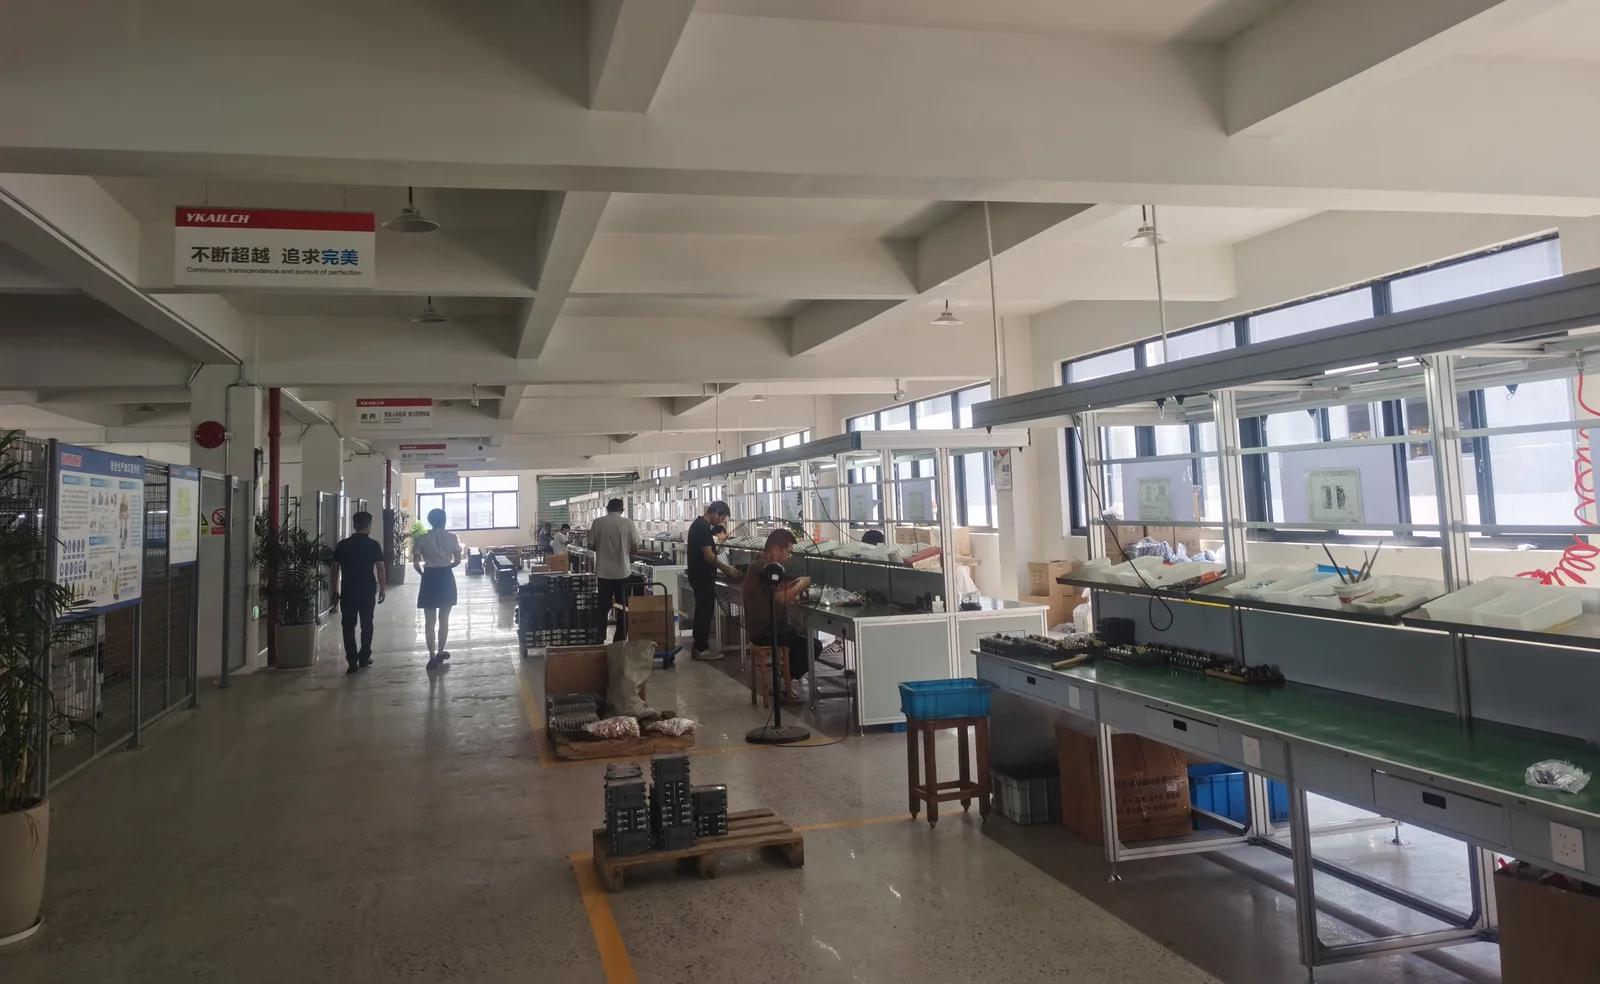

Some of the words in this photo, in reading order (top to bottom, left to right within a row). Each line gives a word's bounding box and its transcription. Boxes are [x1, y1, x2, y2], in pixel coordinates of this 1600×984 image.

[186, 213, 250, 224] YKAILCH
[191, 246, 270, 264] 不断超越
[281, 248, 359, 266] 追求完美
[186, 266, 227, 274] Continuous
[228, 267, 280, 275] transcendence
[295, 268, 319, 276] pursuit
[328, 269, 362, 277] perfection
